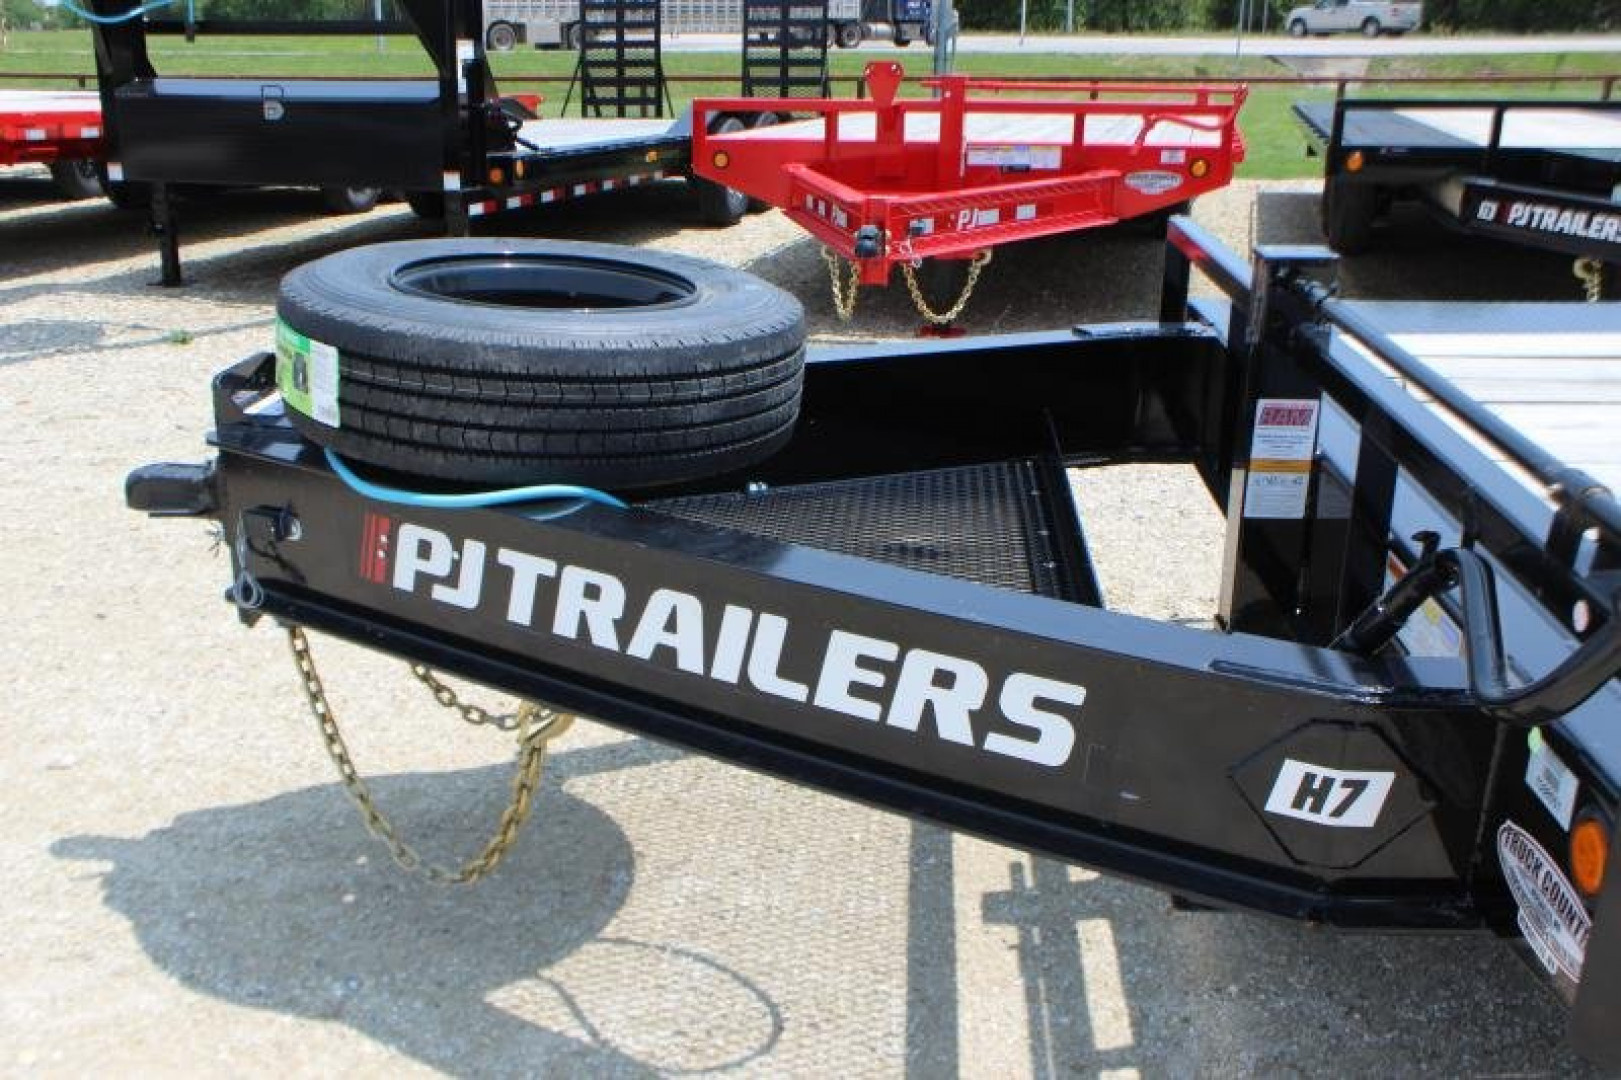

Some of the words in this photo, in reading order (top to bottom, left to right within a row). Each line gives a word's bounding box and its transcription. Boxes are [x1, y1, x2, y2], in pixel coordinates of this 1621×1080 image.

[1507, 201, 1533, 226] PJ
[393, 523, 486, 610] PJ
[498, 548, 1087, 766] TRAILERS
[1290, 771, 1370, 818] H7
[1500, 830, 1543, 882] TRUCK
